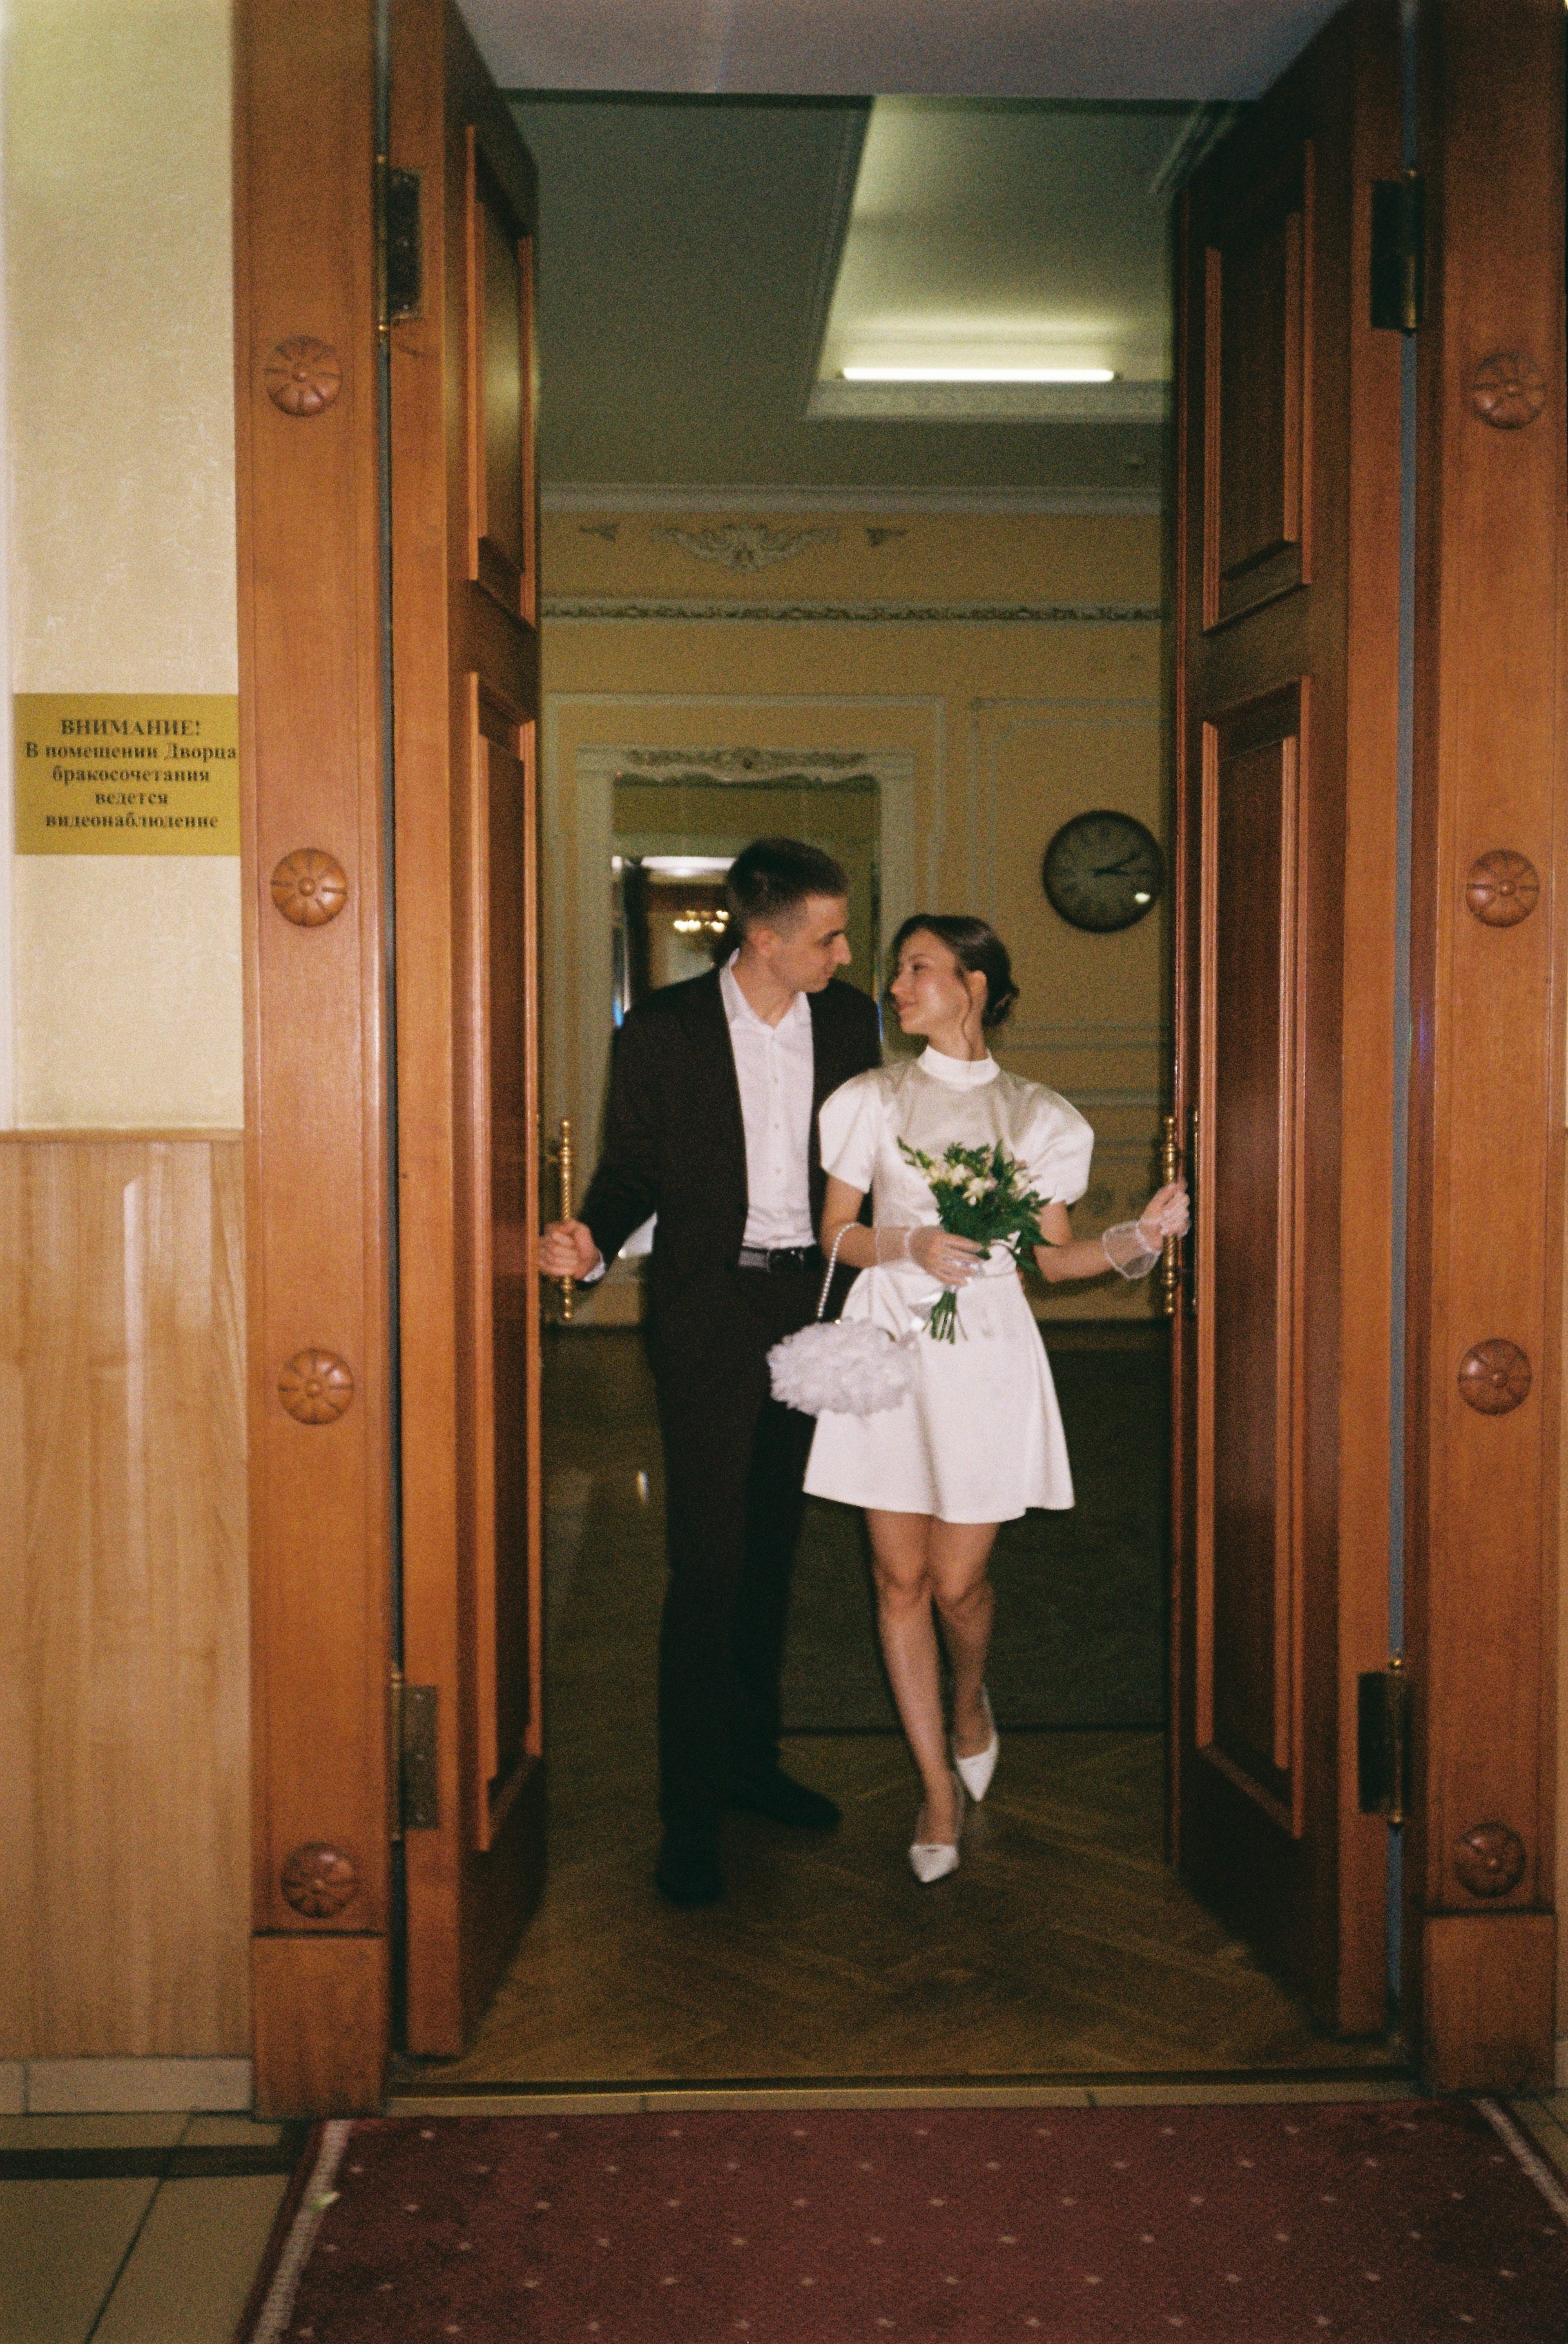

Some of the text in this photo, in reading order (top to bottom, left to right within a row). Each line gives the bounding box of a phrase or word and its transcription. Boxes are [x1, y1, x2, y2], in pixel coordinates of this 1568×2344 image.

[61, 719, 200, 736] ВНИМАНИЕ!
[26, 742, 39, 759] В
[164, 743, 237, 762] Дворца
[52, 765, 209, 786] бракосочетания
[95, 793, 168, 806] ведется
[46, 812, 218, 828] видеонаблюдение
